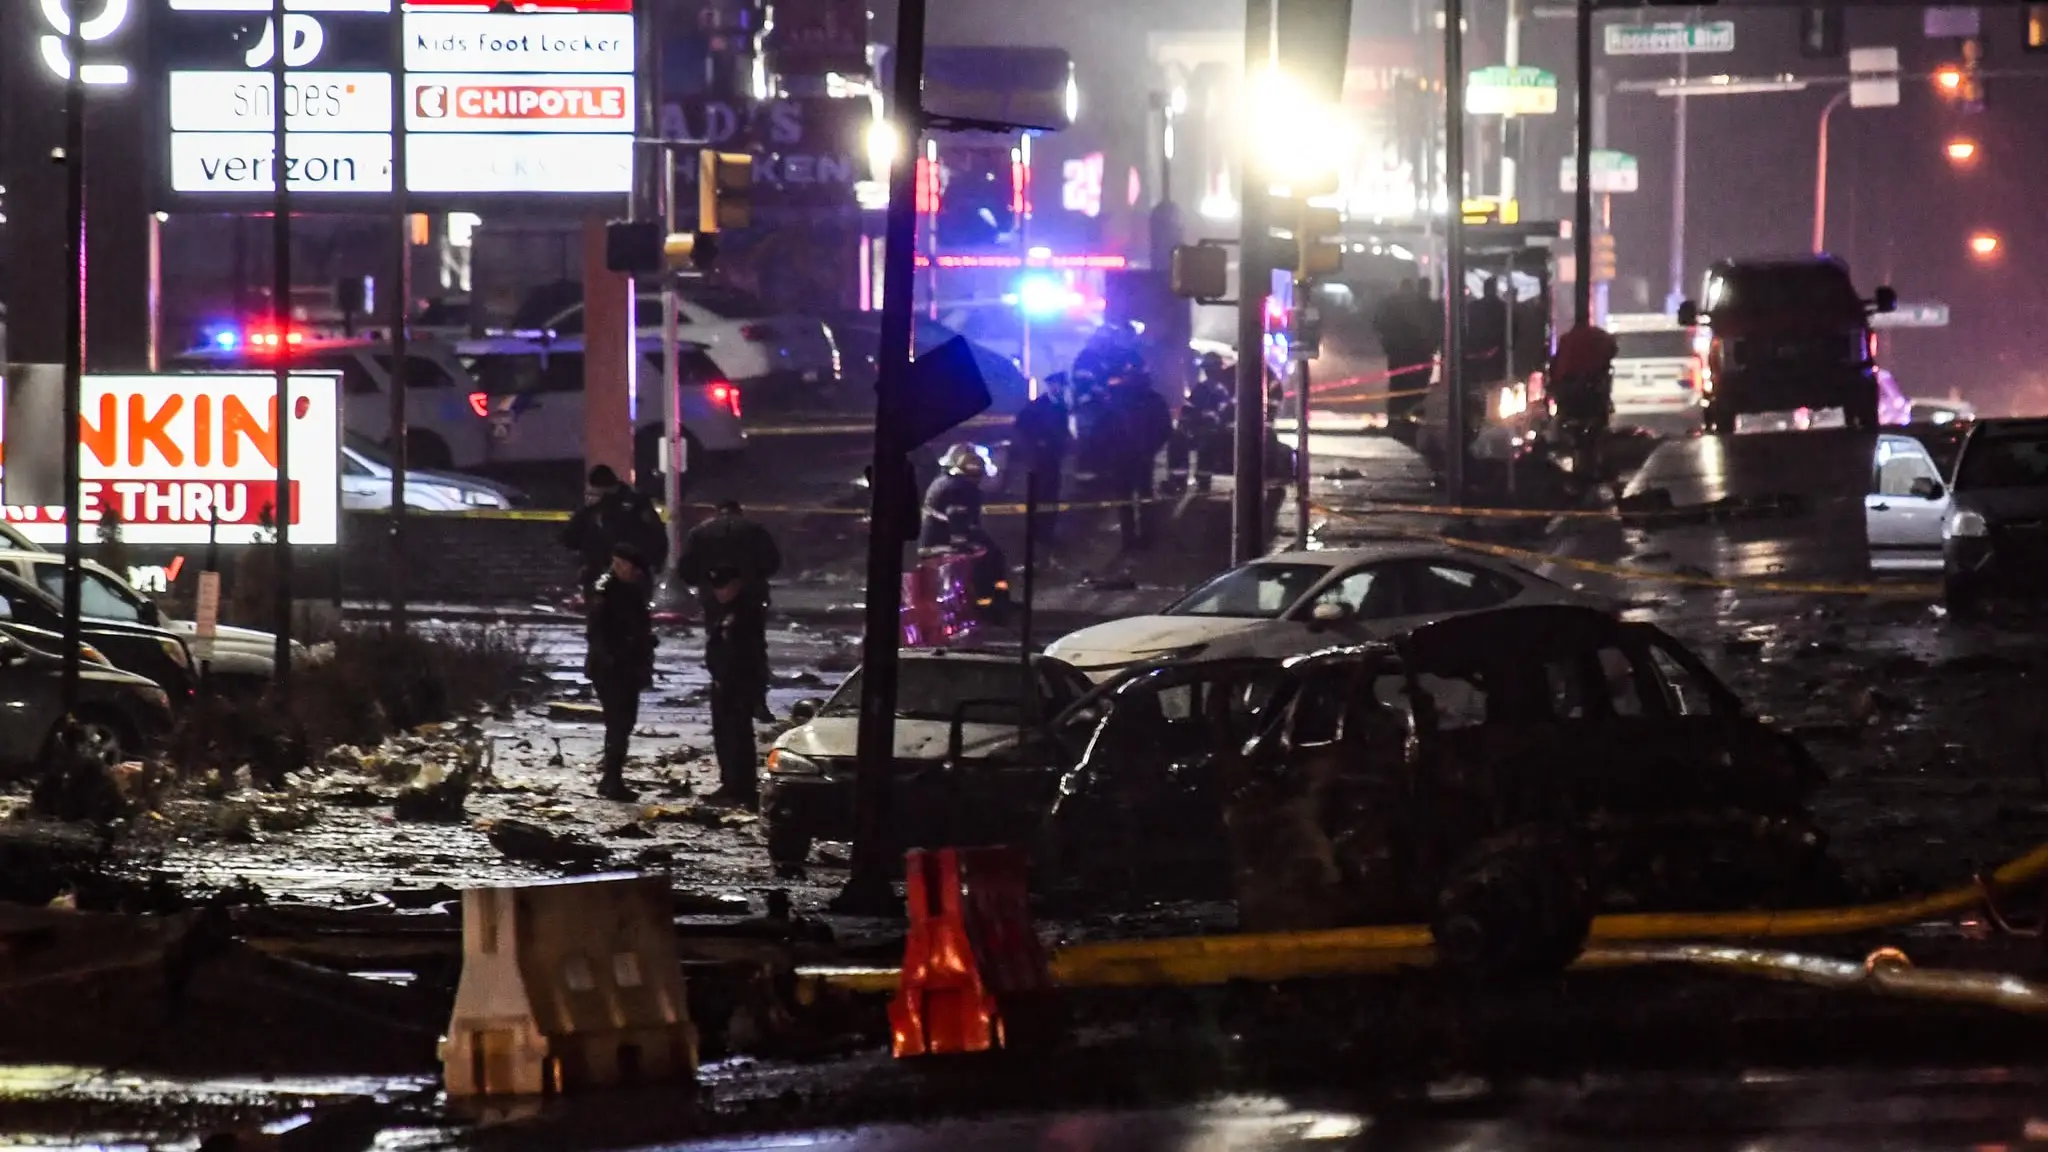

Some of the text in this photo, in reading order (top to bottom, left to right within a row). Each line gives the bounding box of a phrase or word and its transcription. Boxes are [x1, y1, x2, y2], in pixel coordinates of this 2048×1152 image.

[245, 14, 323, 67] JD
[417, 34, 620, 51] Kids Foot Locker
[459, 89, 622, 116] CHIPOTLE
[660, 102, 802, 144] AD'S
[113, 482, 248, 522] THRU
